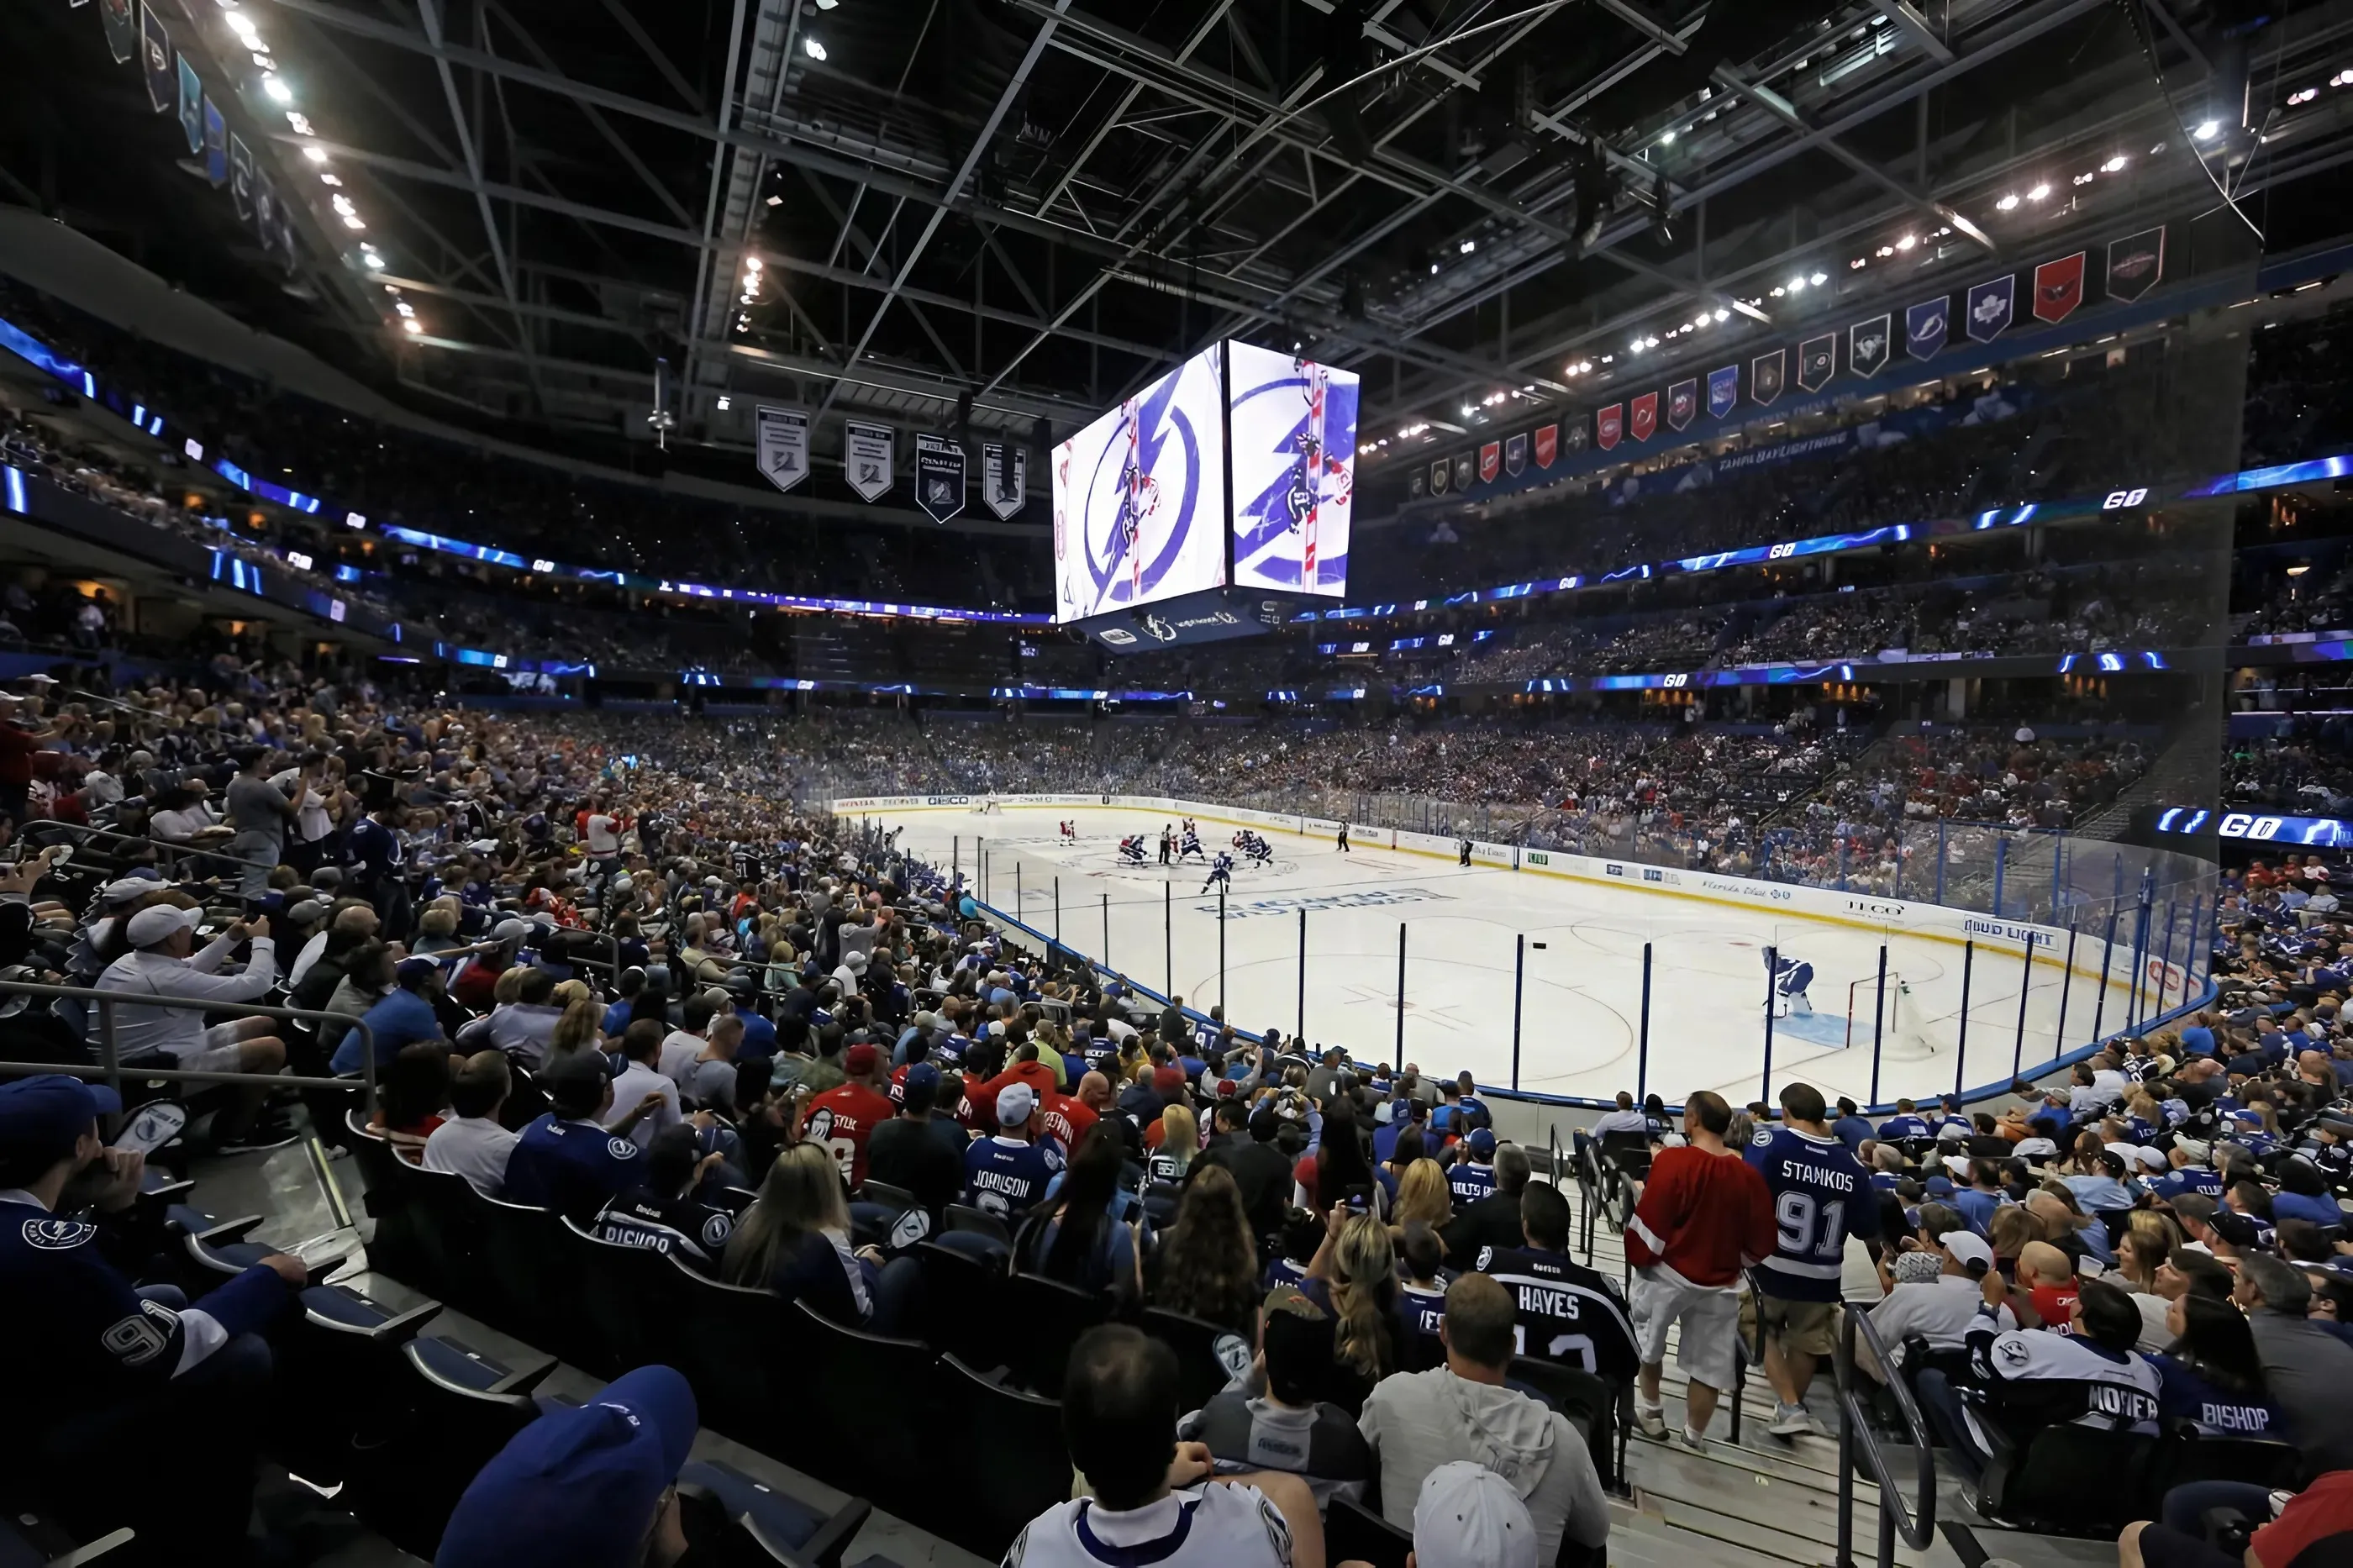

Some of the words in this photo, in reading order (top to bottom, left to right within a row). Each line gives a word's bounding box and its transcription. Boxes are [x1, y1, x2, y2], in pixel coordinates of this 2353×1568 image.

[2103, 488, 2148, 509] GO
[1769, 543, 1796, 559] GO
[1663, 673, 1687, 687] GO
[928, 796, 969, 805] GEICO
[2219, 813, 2282, 839] GO
[1776, 1190, 1845, 1258] 91
[1519, 1285, 1580, 1320] HAYES
[2202, 1402, 2270, 1431] BISHOP
